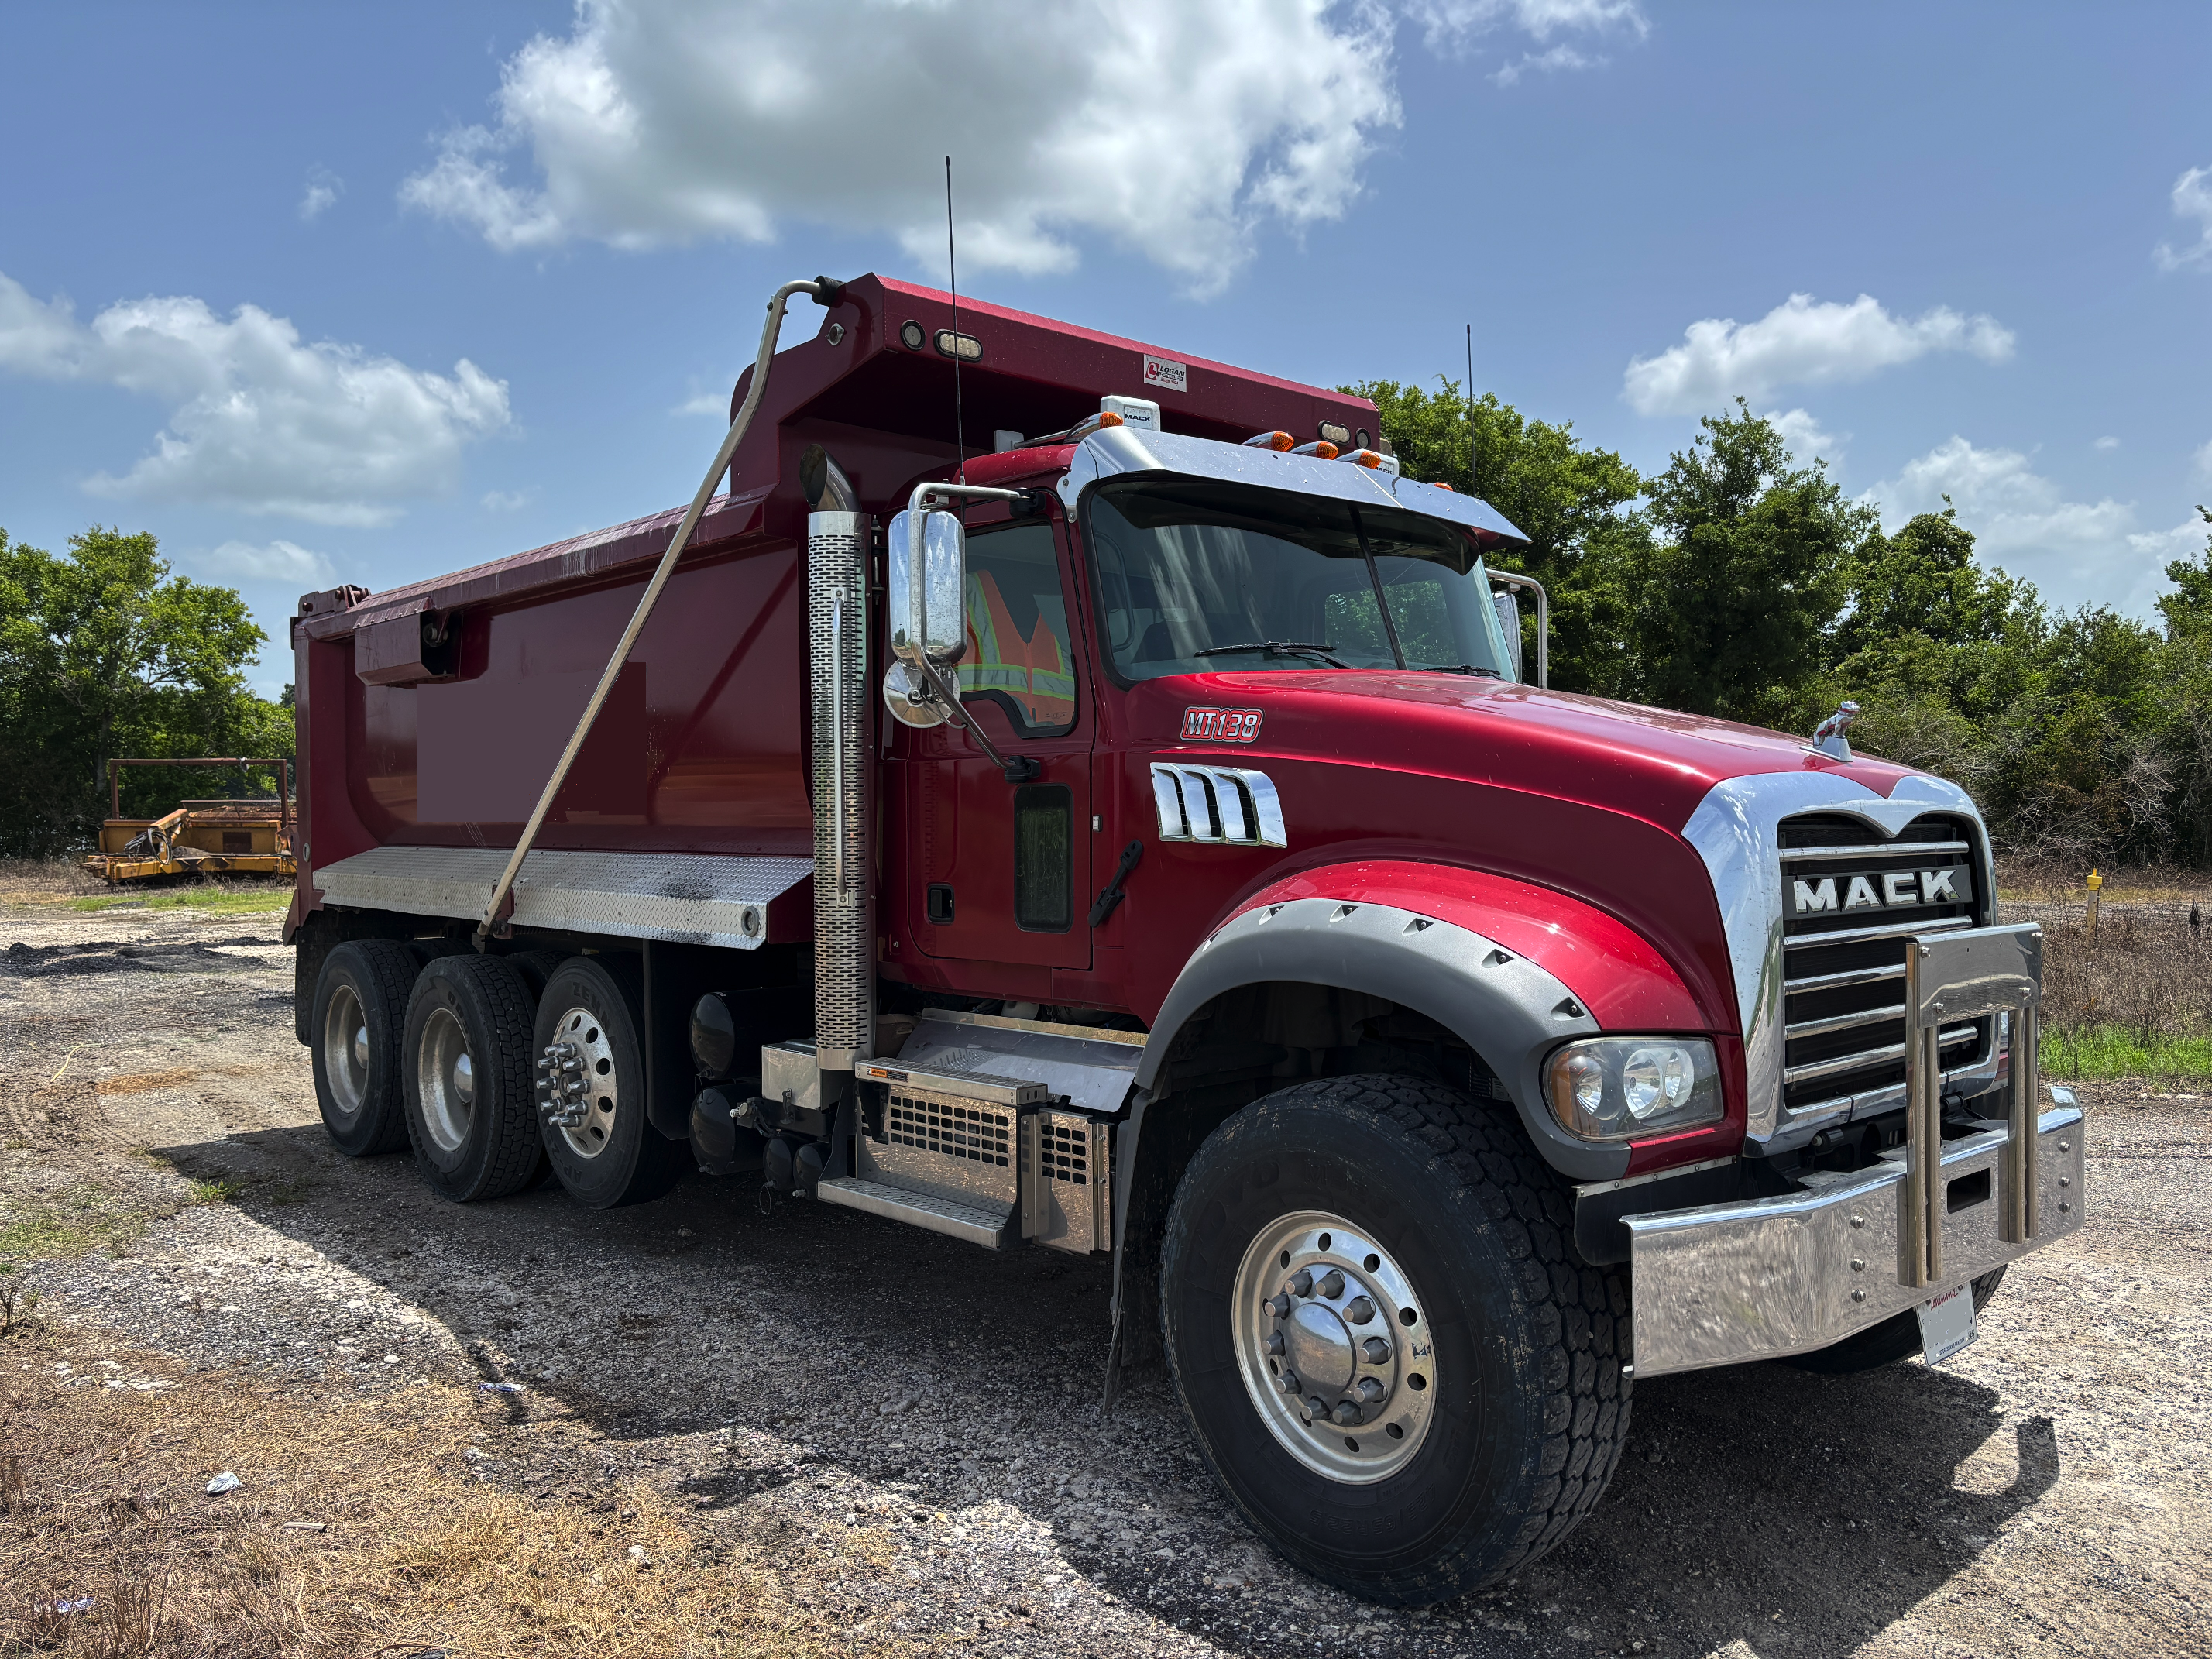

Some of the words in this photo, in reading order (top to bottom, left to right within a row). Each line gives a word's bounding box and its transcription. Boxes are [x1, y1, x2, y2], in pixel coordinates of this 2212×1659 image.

[1159, 366, 1185, 377] LOGAN
[1125, 414, 1151, 422] MACK
[1183, 709, 1261, 740] MT138
[1792, 868, 1962, 915] MACK
